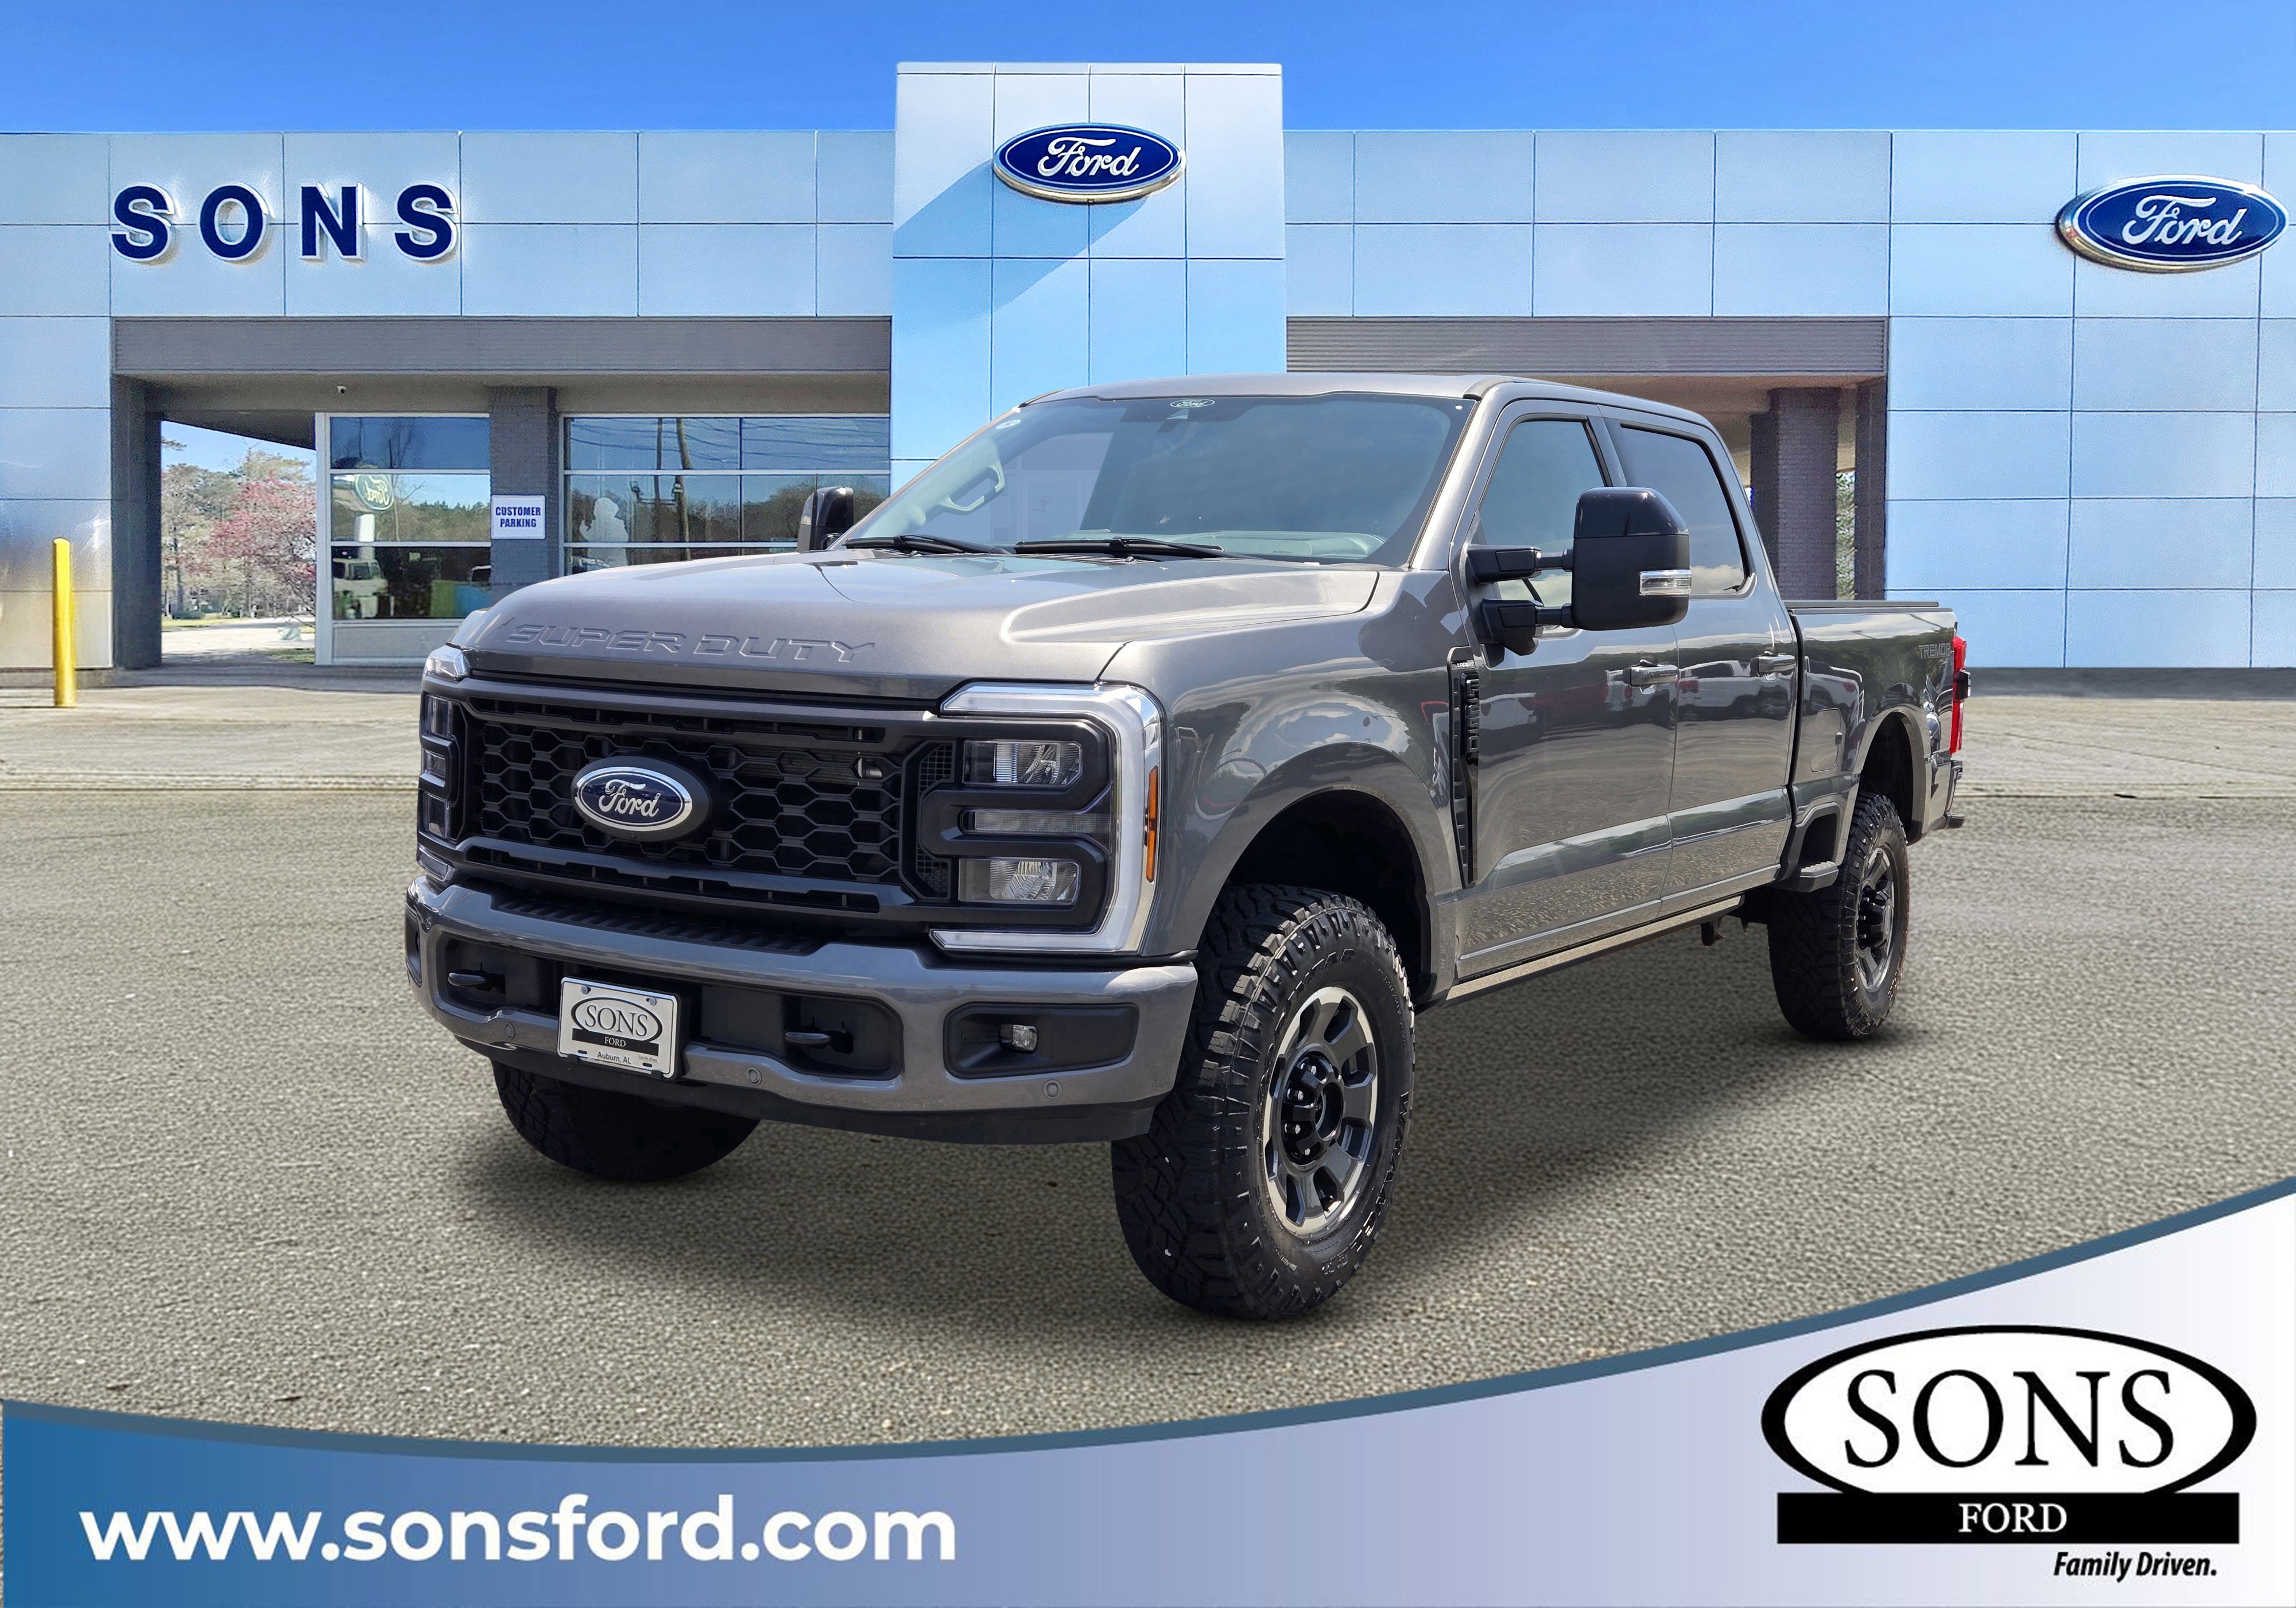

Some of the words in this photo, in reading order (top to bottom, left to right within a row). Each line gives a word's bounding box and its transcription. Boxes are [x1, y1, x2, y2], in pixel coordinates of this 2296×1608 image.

[1037, 137, 1142, 177] Ford
[111, 182, 458, 262] SONS
[2122, 195, 2247, 245] Ford
[495, 507, 541, 516] CUSTOMER
[500, 518, 537, 528] PARKING
[506, 623, 688, 654] SUPER
[692, 634, 875, 663] DUTY
[1918, 642, 1952, 659] TREMOR
[598, 778, 660, 818] Ford
[584, 1004, 648, 1037] SONS
[597, 1051, 622, 1064] Auburn,
[623, 1056, 631, 1065] AL
[604, 1036, 626, 1047] FORD
